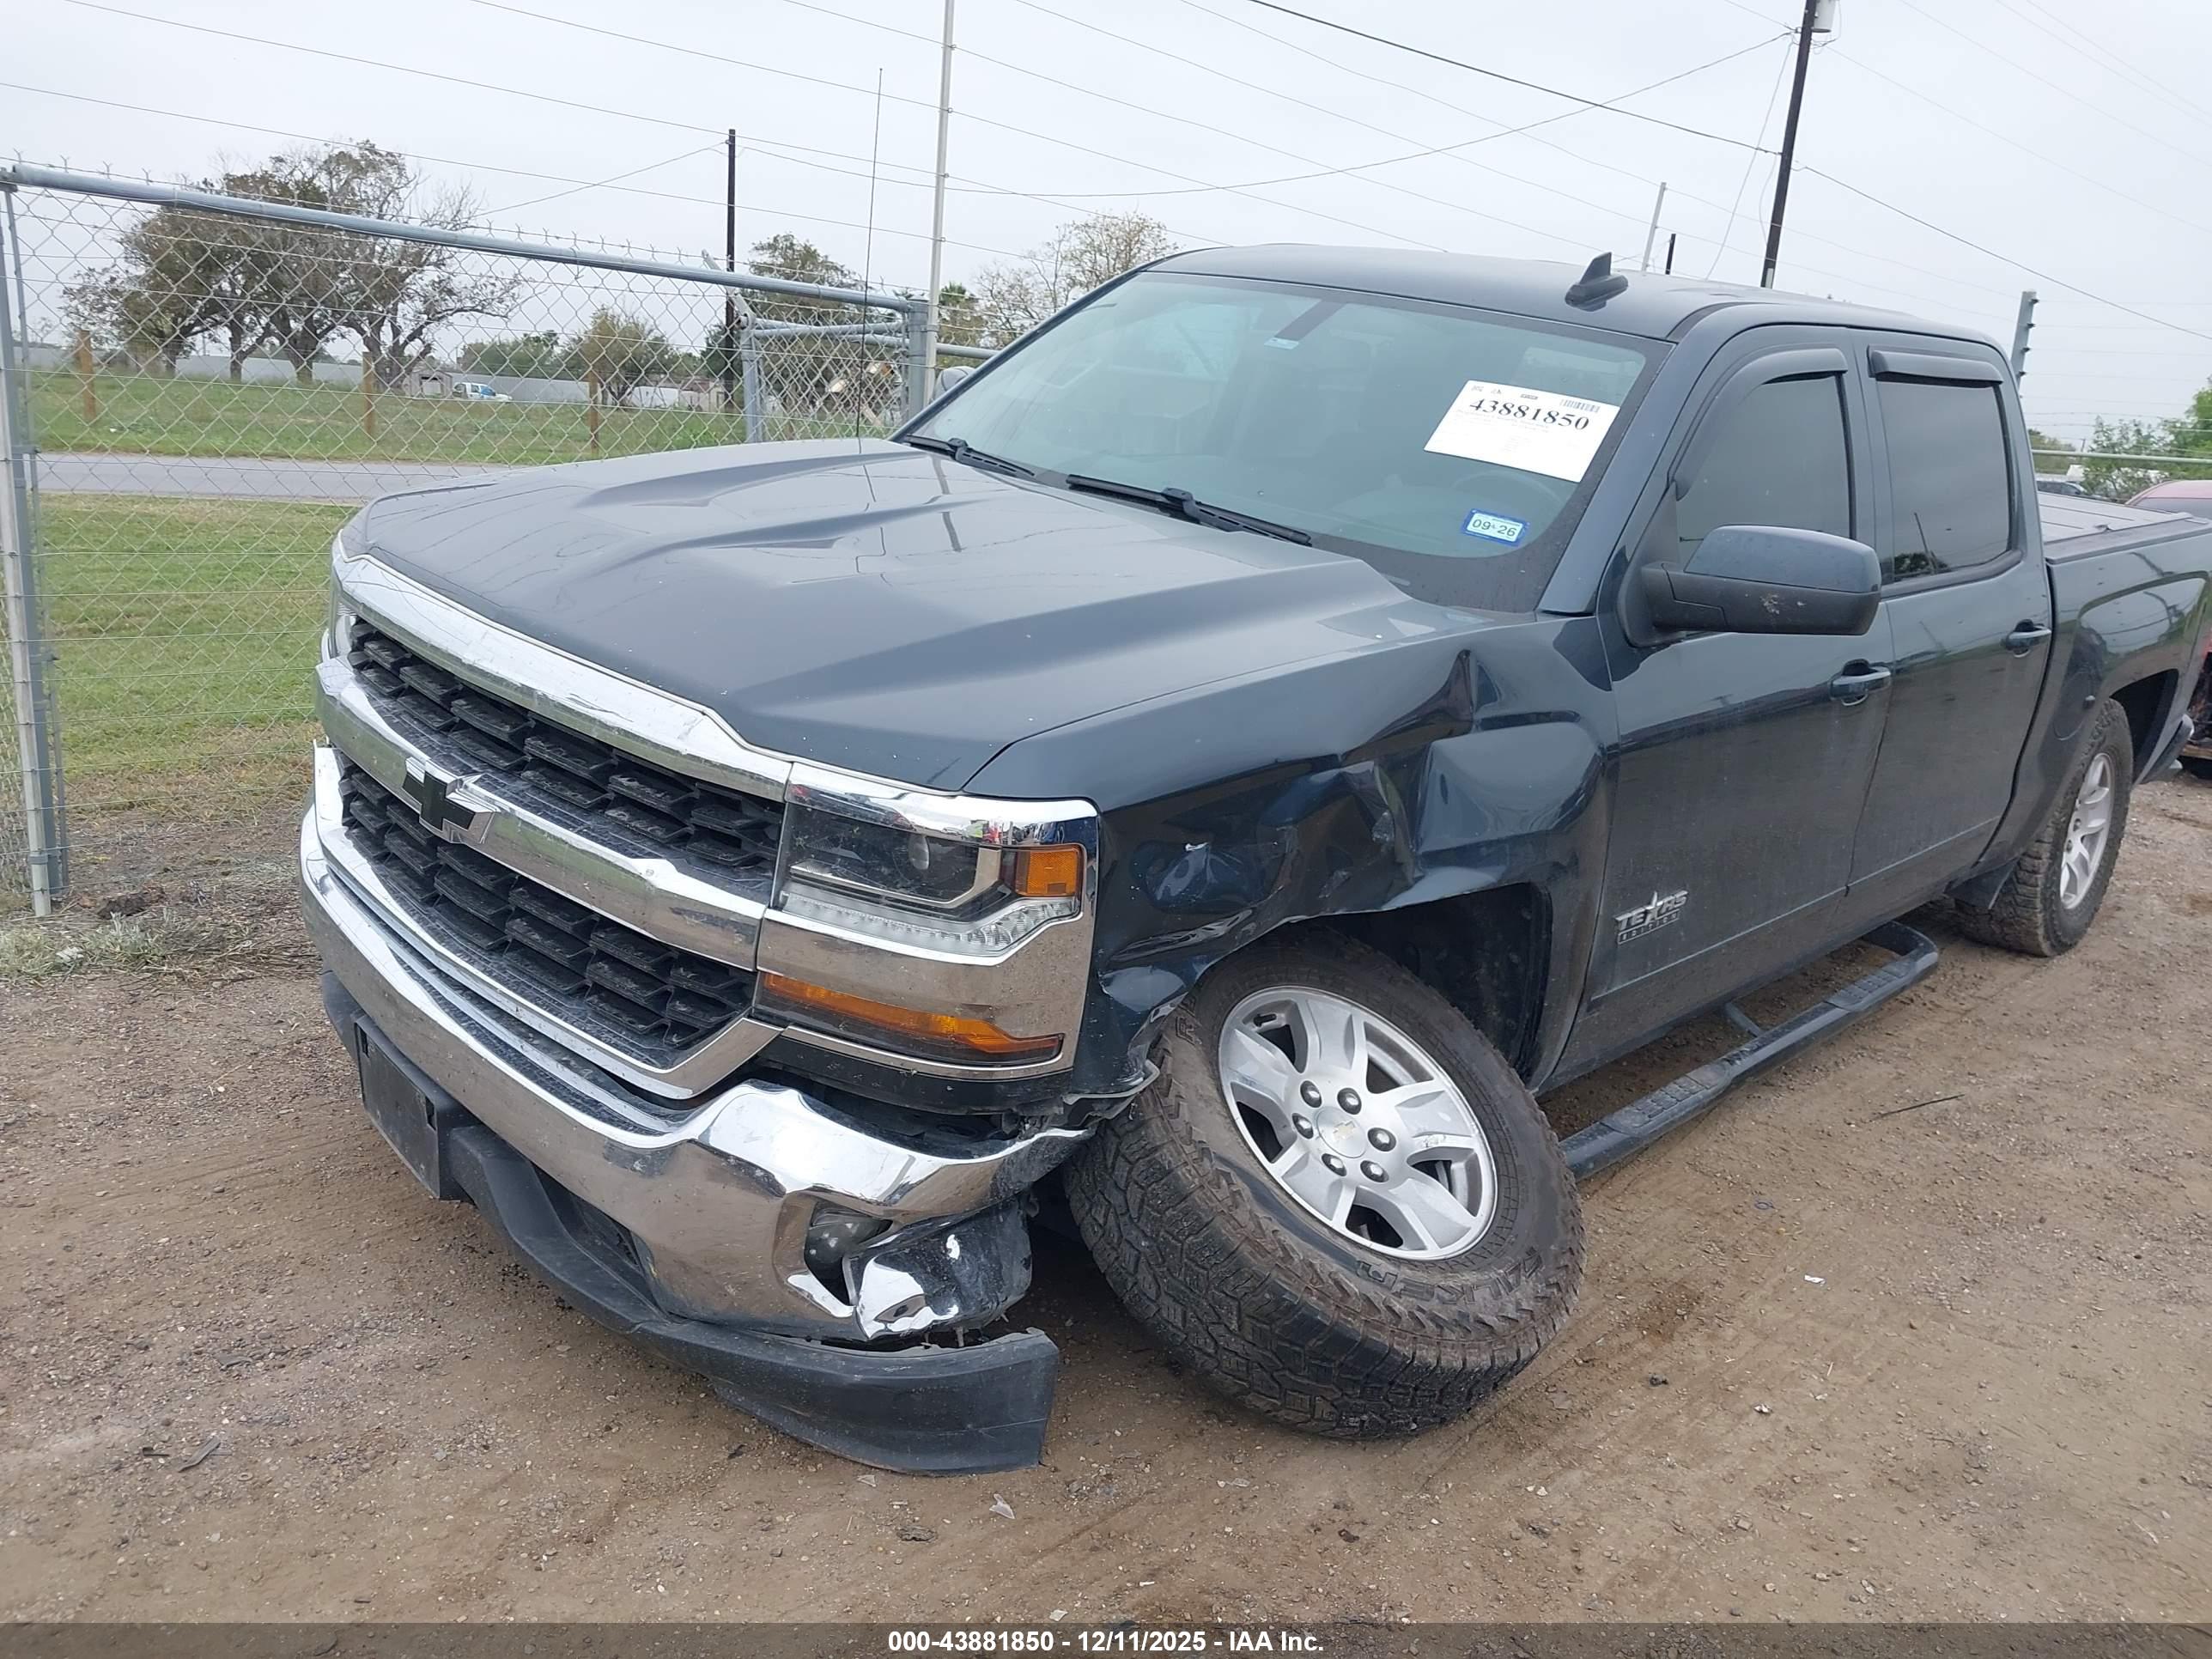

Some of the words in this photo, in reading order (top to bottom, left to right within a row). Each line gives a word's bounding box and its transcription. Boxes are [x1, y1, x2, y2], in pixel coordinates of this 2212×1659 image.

[1469, 398, 1589, 430] 43881850
[1472, 519, 1492, 531] 09
[1497, 525, 1517, 537] 26
[1615, 890, 1688, 930] TEXAS
